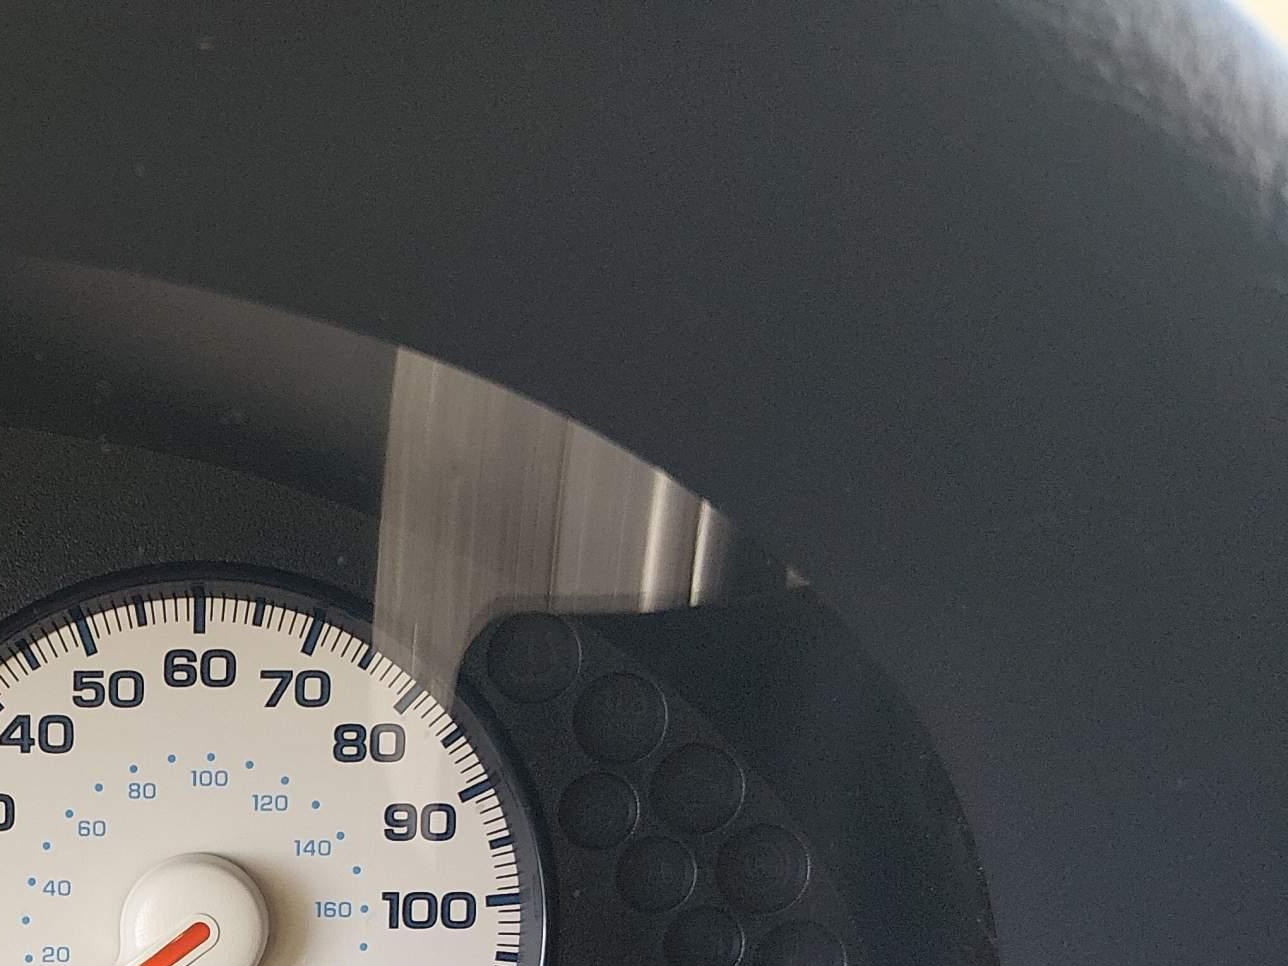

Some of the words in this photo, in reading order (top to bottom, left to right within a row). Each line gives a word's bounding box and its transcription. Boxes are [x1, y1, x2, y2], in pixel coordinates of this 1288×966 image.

[164, 649, 236, 687] 60
[73, 670, 144, 708] 50
[260, 670, 331, 707] 70
[333, 724, 405, 762] 80
[192, 771, 228, 786] 100
[129, 783, 156, 799] 80
[253, 795, 288, 811] 120
[78, 821, 105, 836] 60
[384, 803, 456, 841] 90
[295, 840, 331, 856] 140
[43, 880, 71, 896] 40
[315, 902, 351, 917] 160
[382, 892, 476, 929] 100
[43, 947, 69, 962] 20
